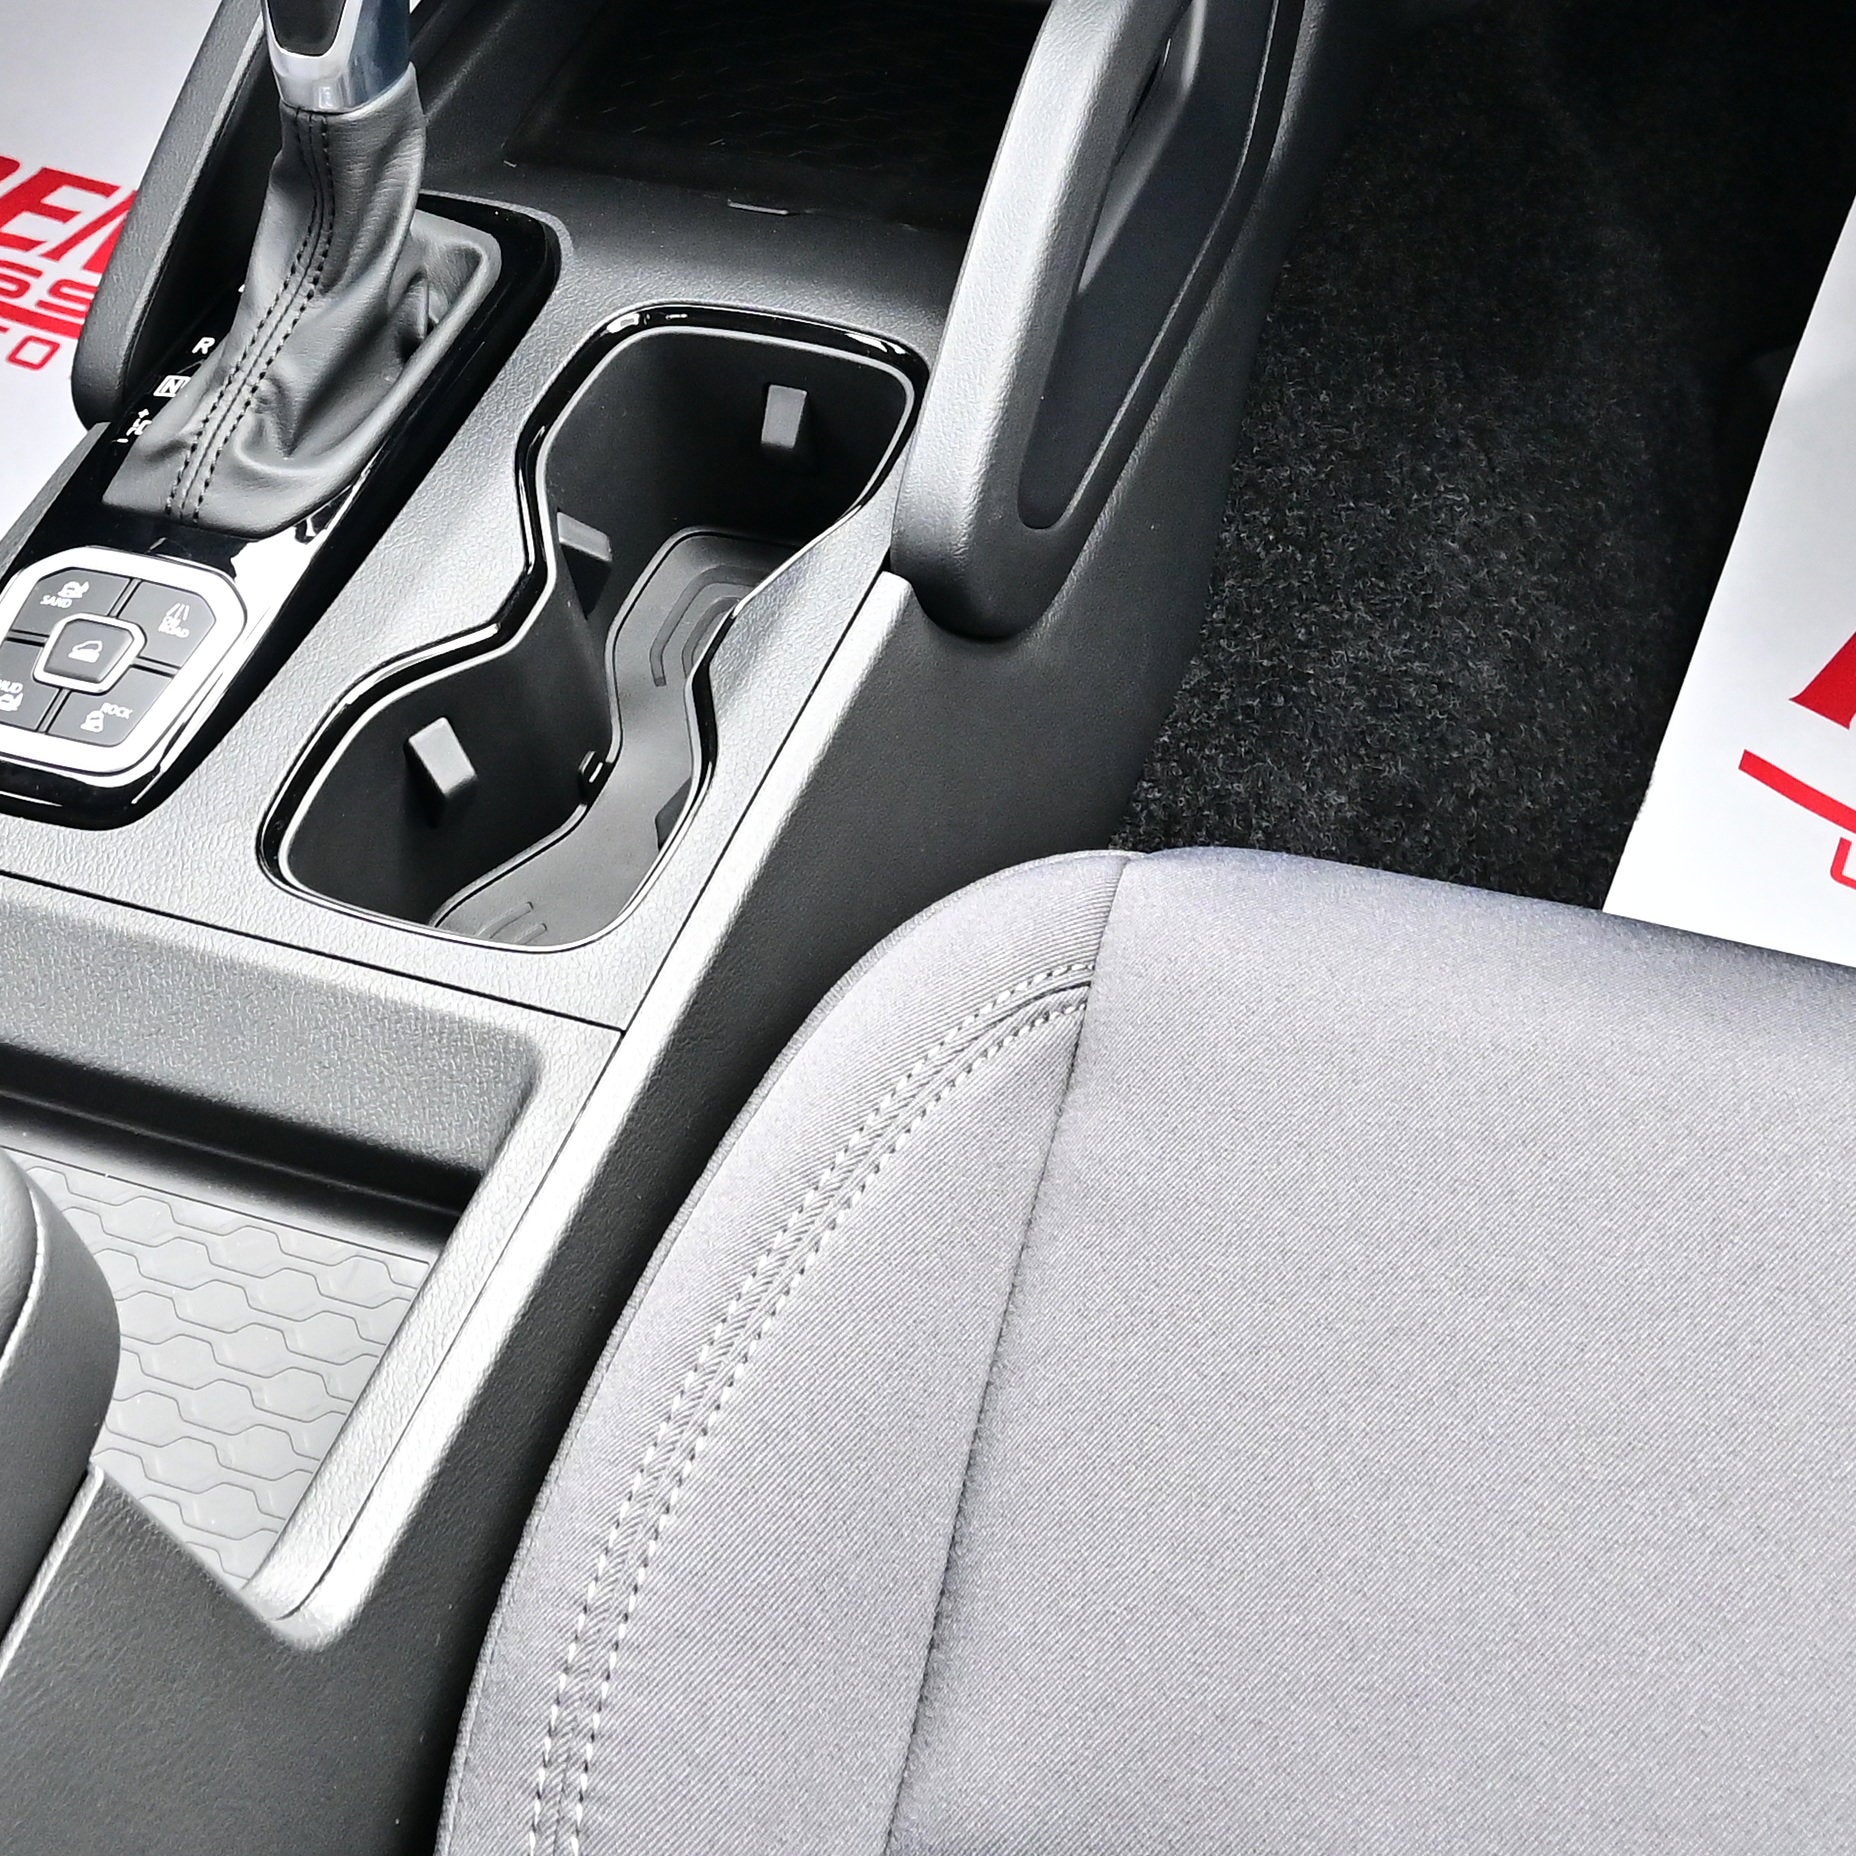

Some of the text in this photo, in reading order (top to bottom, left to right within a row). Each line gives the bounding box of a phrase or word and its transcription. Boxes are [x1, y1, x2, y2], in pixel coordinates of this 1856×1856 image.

[191, 337, 216, 355] R
[40, 594, 72, 609] SAND
[101, 702, 134, 720] ROCK
